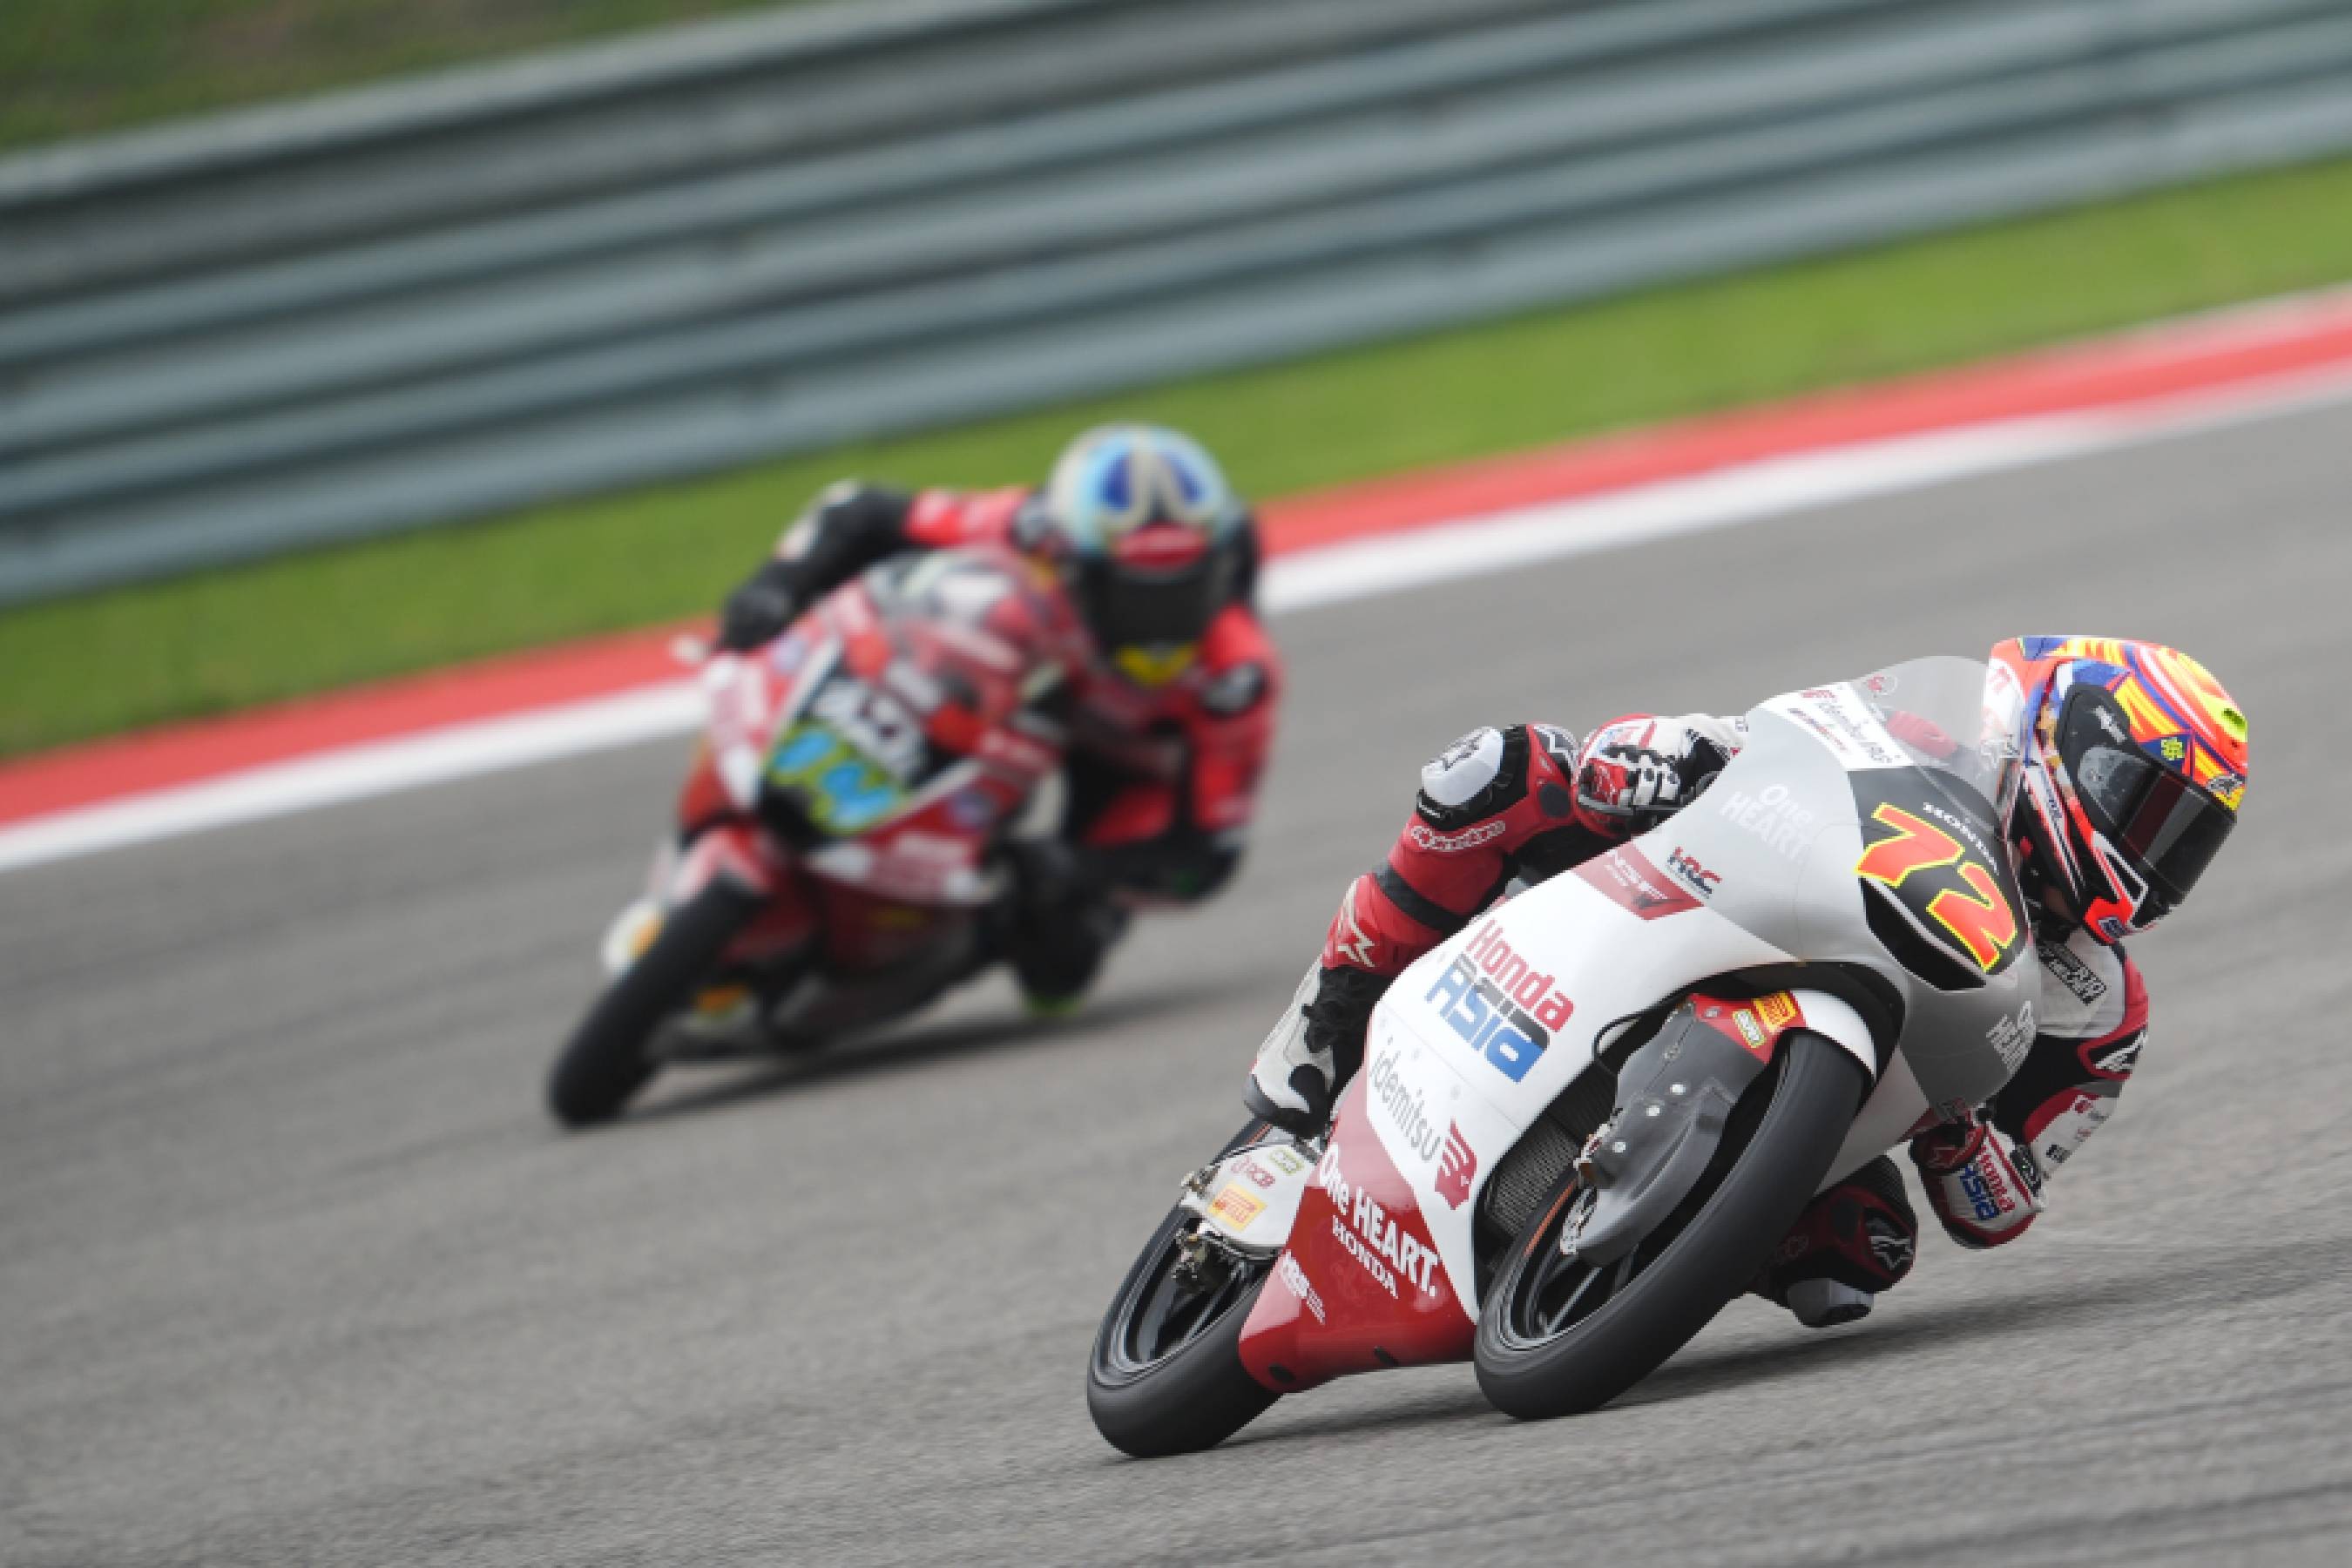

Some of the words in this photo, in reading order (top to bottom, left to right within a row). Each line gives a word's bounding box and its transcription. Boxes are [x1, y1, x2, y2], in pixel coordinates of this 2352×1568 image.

[1667, 846, 1722, 895] HRC
[1923, 801, 2000, 876] HONDA
[1853, 801, 2018, 973] 72
[1465, 919, 1575, 1032] Honda
[1369, 1034, 1441, 1162] idemitsu
[1320, 1142, 1349, 1216] One
[1333, 1214, 1399, 1300] HONDA
